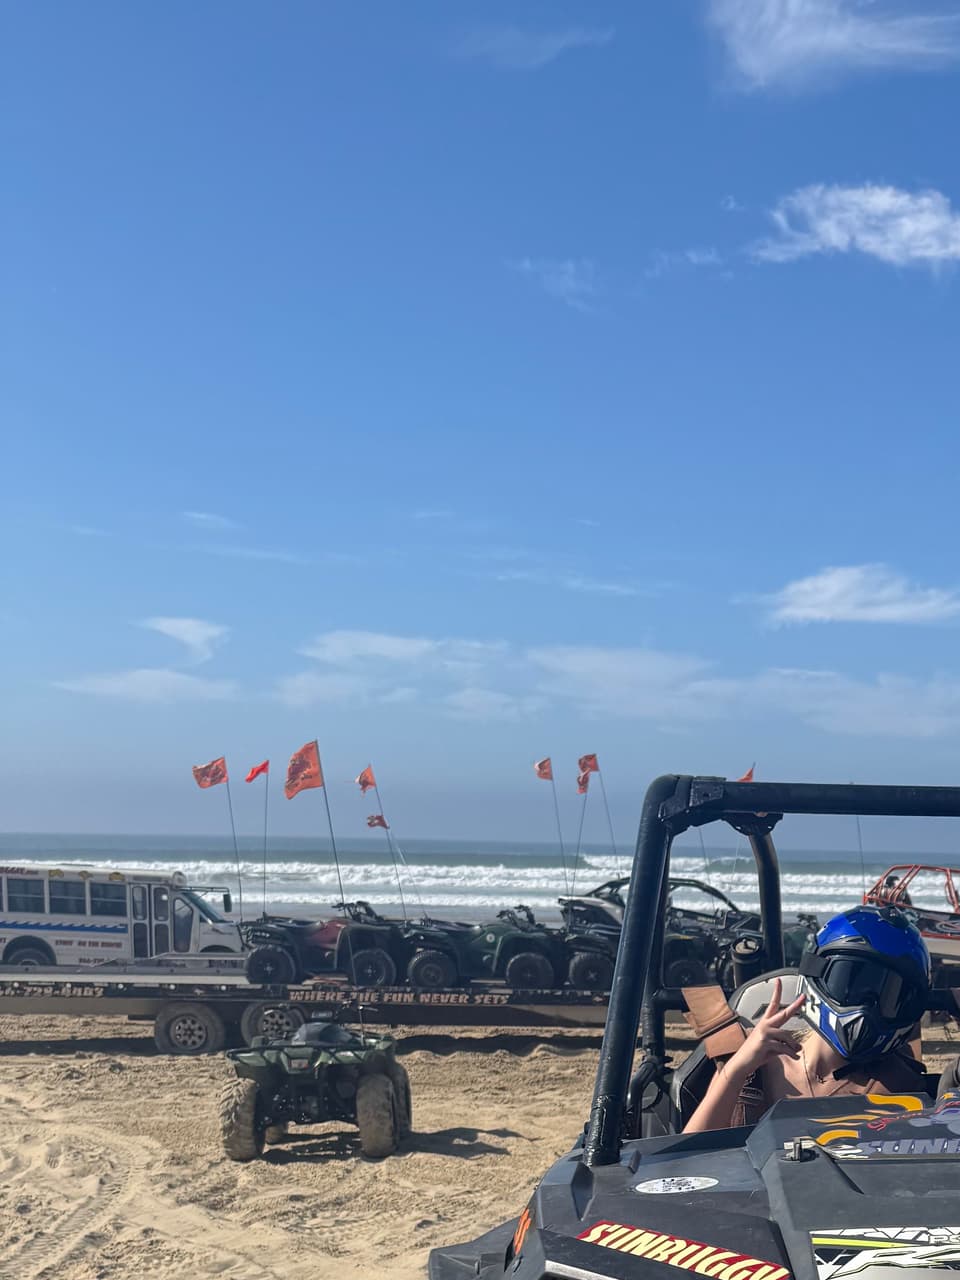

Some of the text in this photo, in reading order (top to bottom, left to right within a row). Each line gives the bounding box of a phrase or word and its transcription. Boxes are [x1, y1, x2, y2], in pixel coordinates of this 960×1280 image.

[289, 991, 346, 1001] WHERE
[383, 992, 416, 1003] FUN
[420, 993, 469, 1004] NEVER
[474, 994, 510, 1005] SETS
